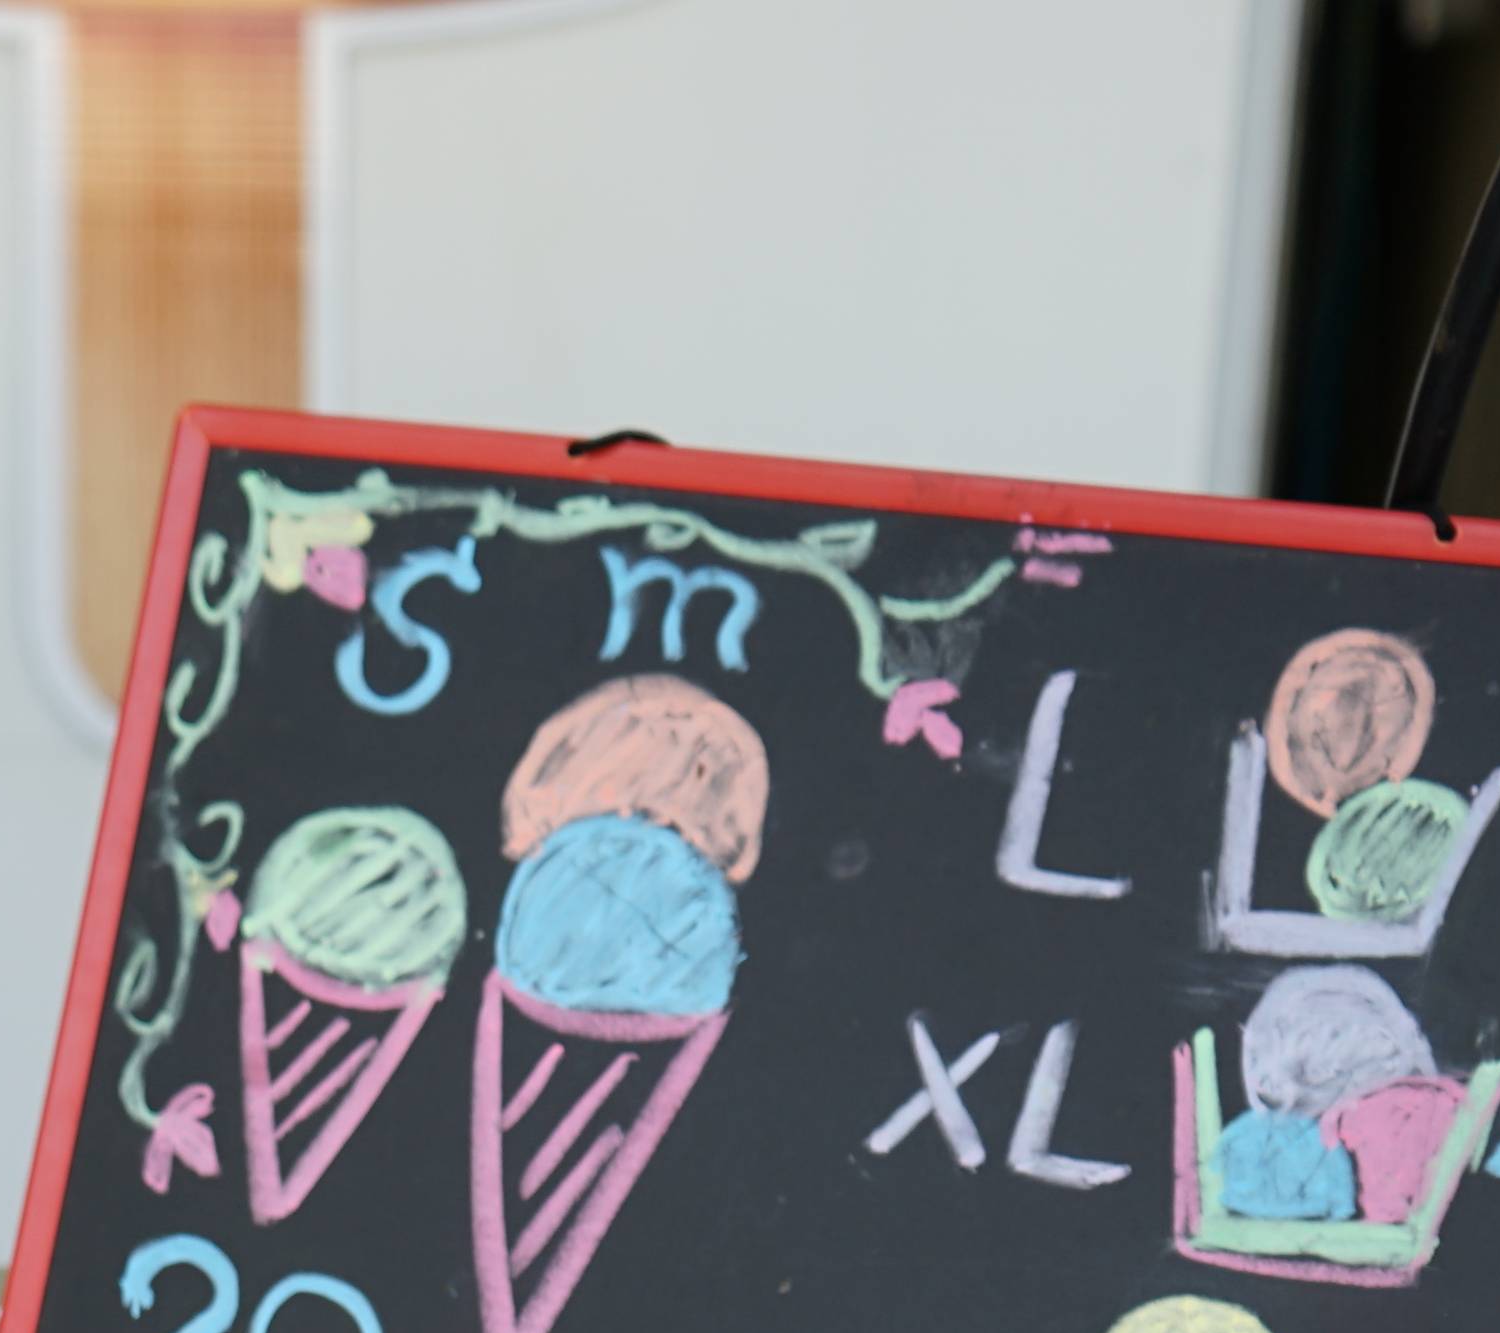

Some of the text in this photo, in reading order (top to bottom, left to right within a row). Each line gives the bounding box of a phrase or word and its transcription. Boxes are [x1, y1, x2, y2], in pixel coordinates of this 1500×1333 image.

[334, 535, 482, 716] S
[997, 670, 1132, 900] L
[863, 1009, 1135, 1189] XL
